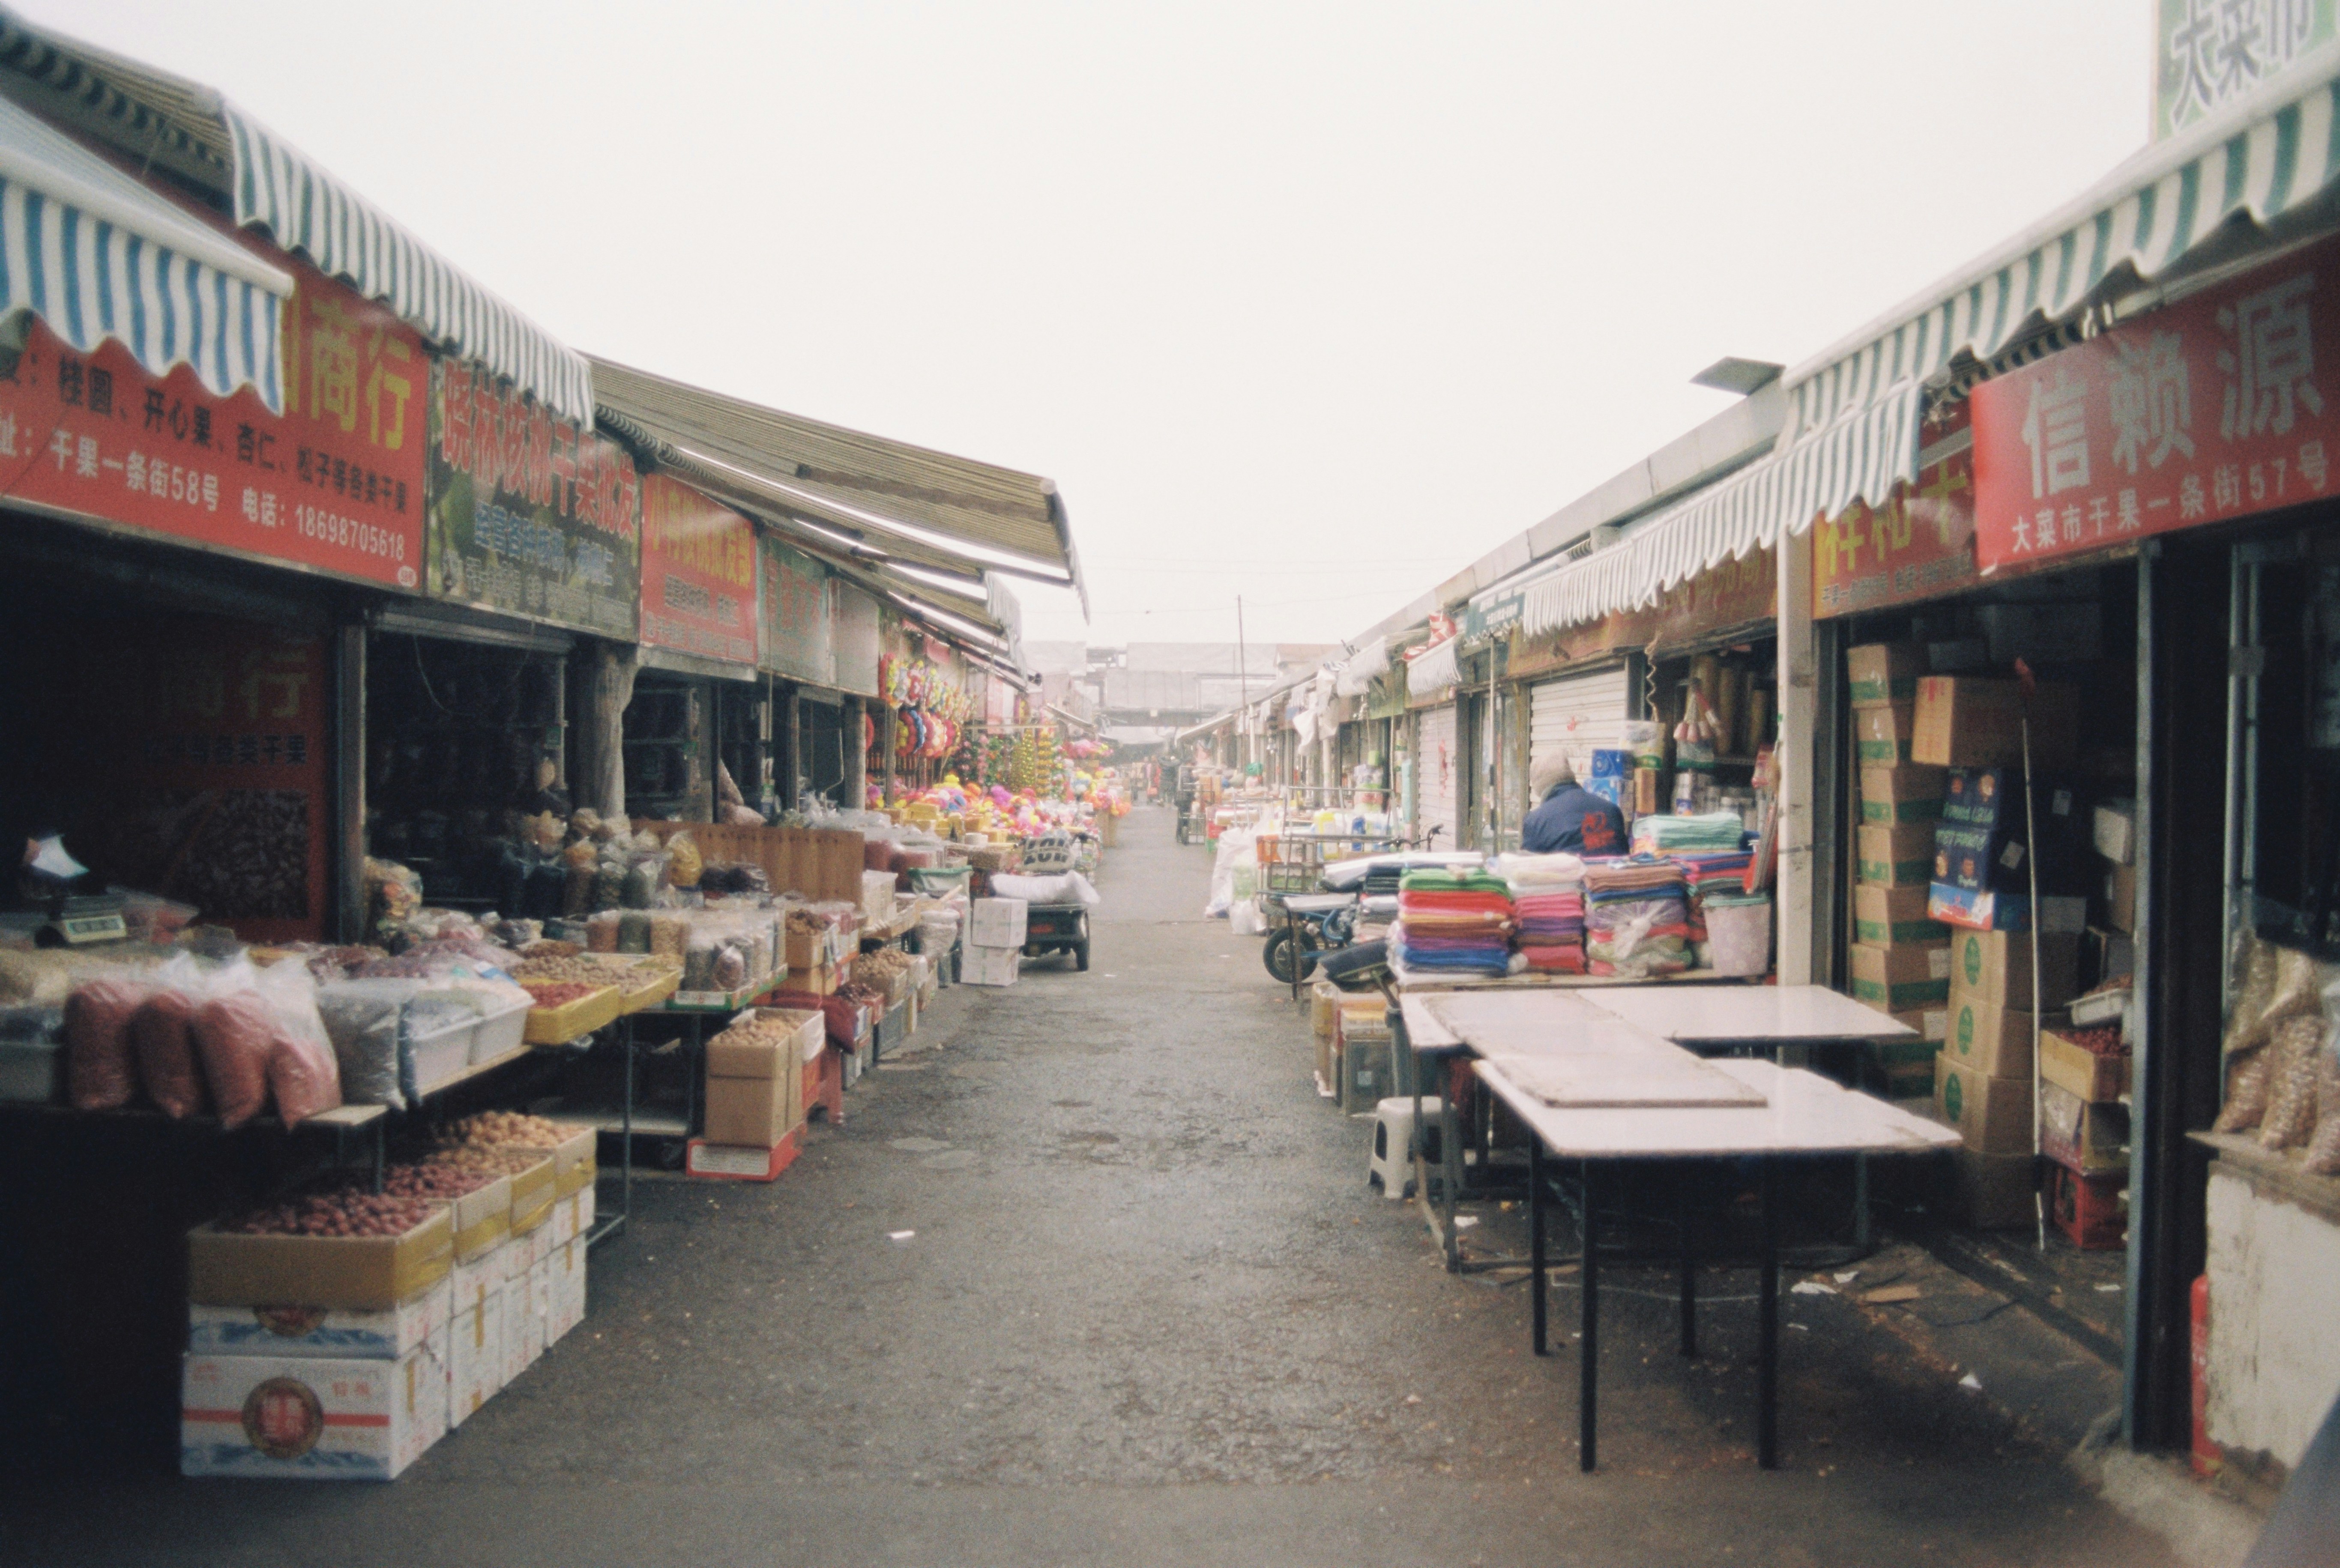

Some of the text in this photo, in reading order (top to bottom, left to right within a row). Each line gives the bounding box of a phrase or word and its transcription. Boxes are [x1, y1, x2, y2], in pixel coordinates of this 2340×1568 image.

[3, 351, 406, 515] ：桂圆、开心果、杏仁、松子等各类干果
[2020, 272, 2325, 500] 信赖源
[242, 486, 405, 561] 电话：18698705618
